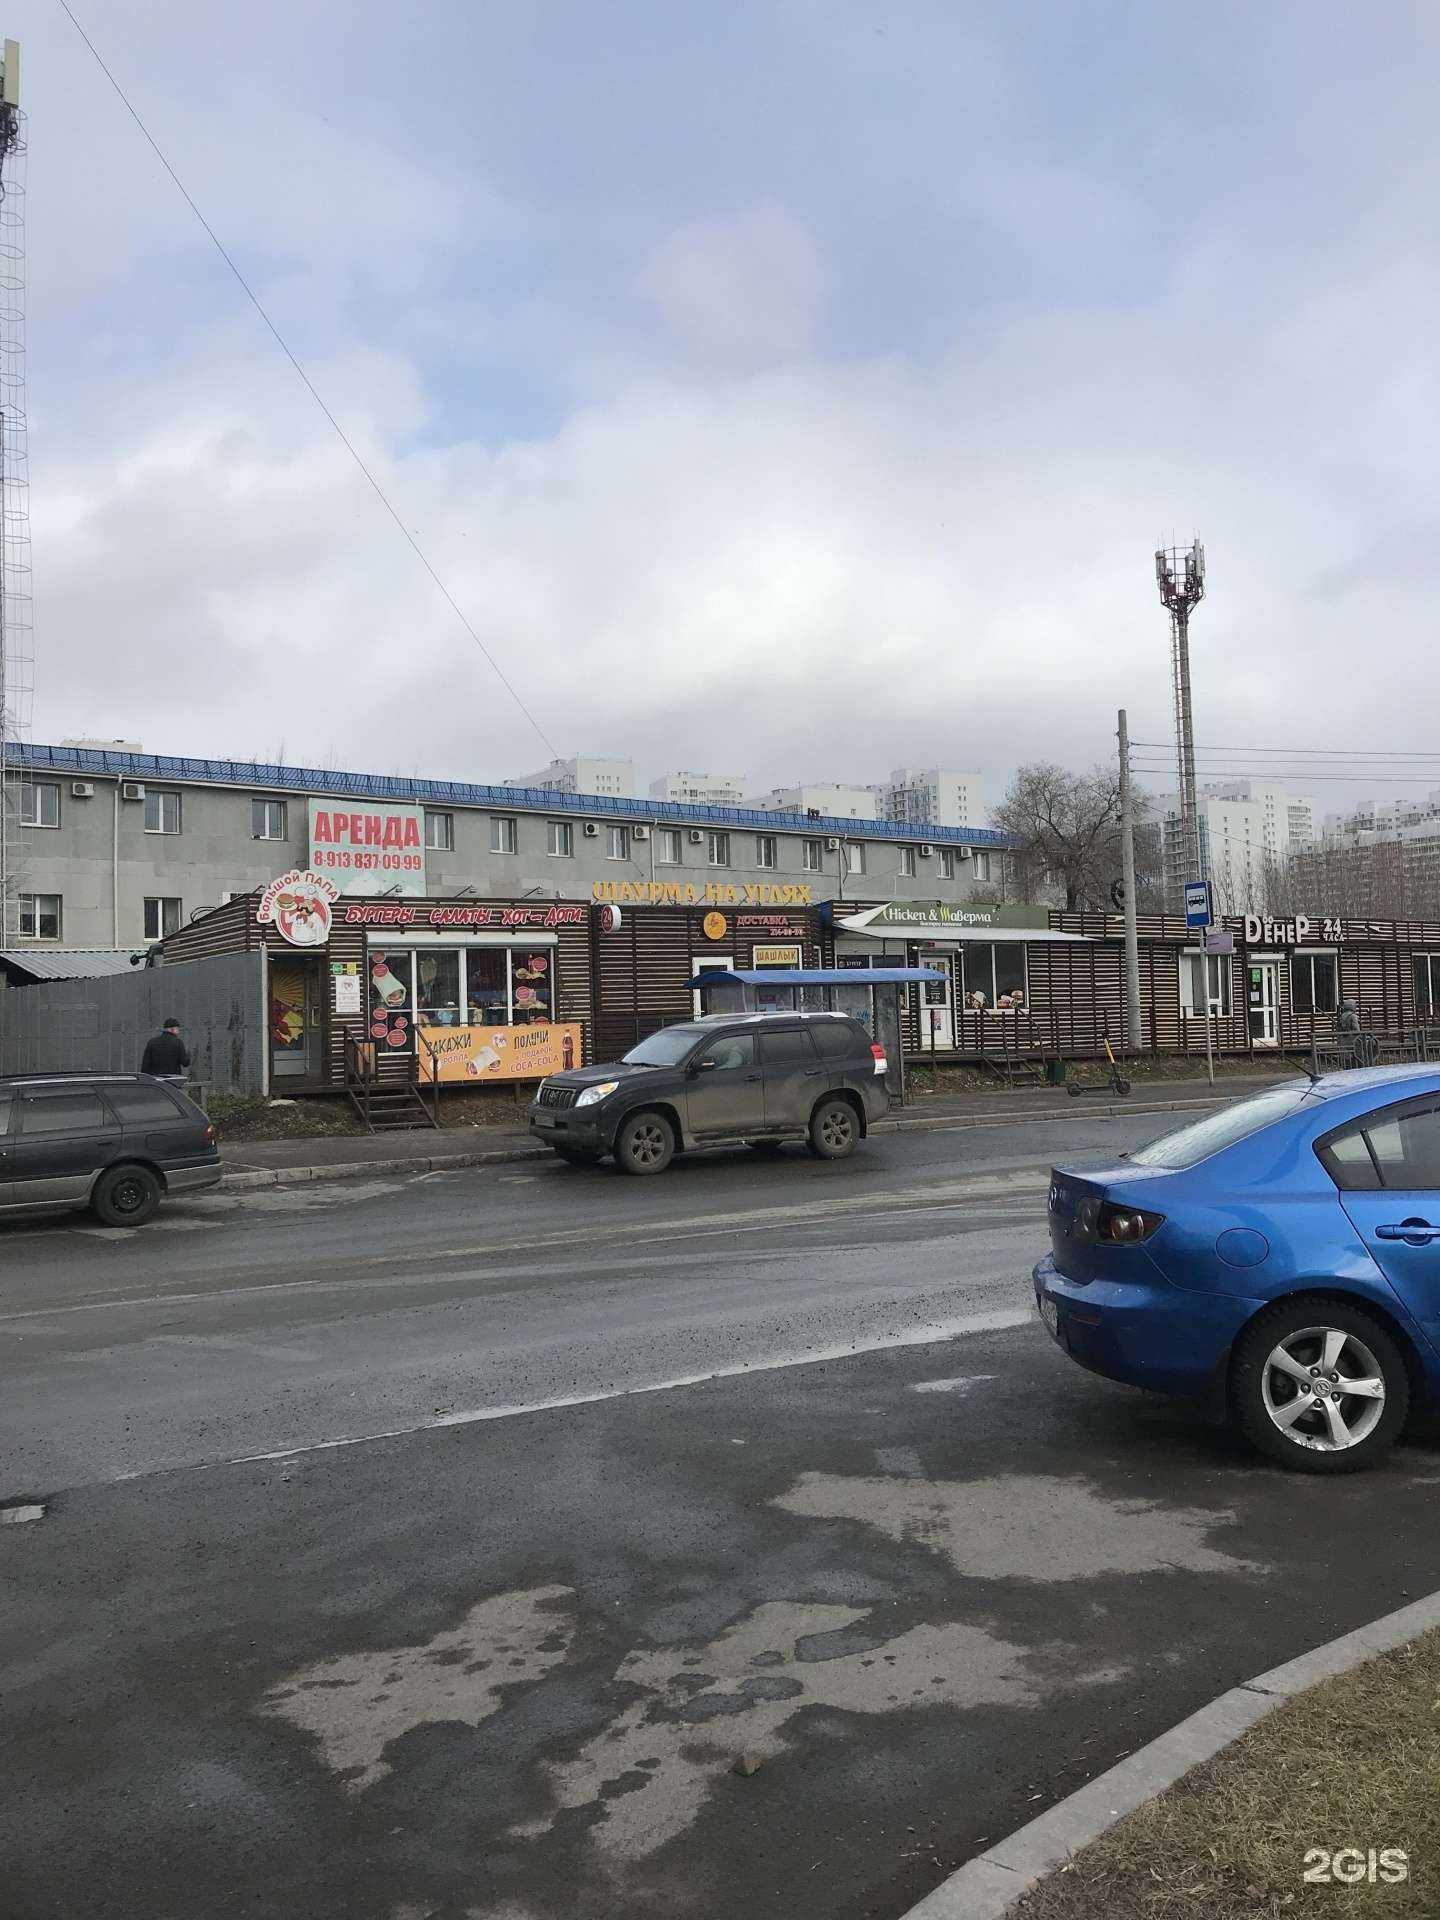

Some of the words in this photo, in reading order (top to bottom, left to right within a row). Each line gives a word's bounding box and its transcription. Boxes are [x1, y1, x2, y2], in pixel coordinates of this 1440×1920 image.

[314, 811, 420, 850] АРЕНДА
[260, 871, 300, 920] БОЛЬШОЙ
[305, 872, 338, 900] ПАПА
[592, 880, 698, 904] ШАУРМА
[704, 882, 738, 902] НА
[741, 883, 812, 906] УГЛЯХ
[345, 906, 416, 923] БУРГЕРЫ
[429, 906, 492, 925] САЛАТЫ
[603, 910, 612, 923] 24
[737, 915, 789, 926] ДОСТАВКА
[1323, 918, 1342, 934] 24
[1322, 932, 1345, 942] ЧАСА
[757, 951, 796, 962] ШАШЛЫК
[514, 1030, 549, 1050] ПОЛУЧИ
